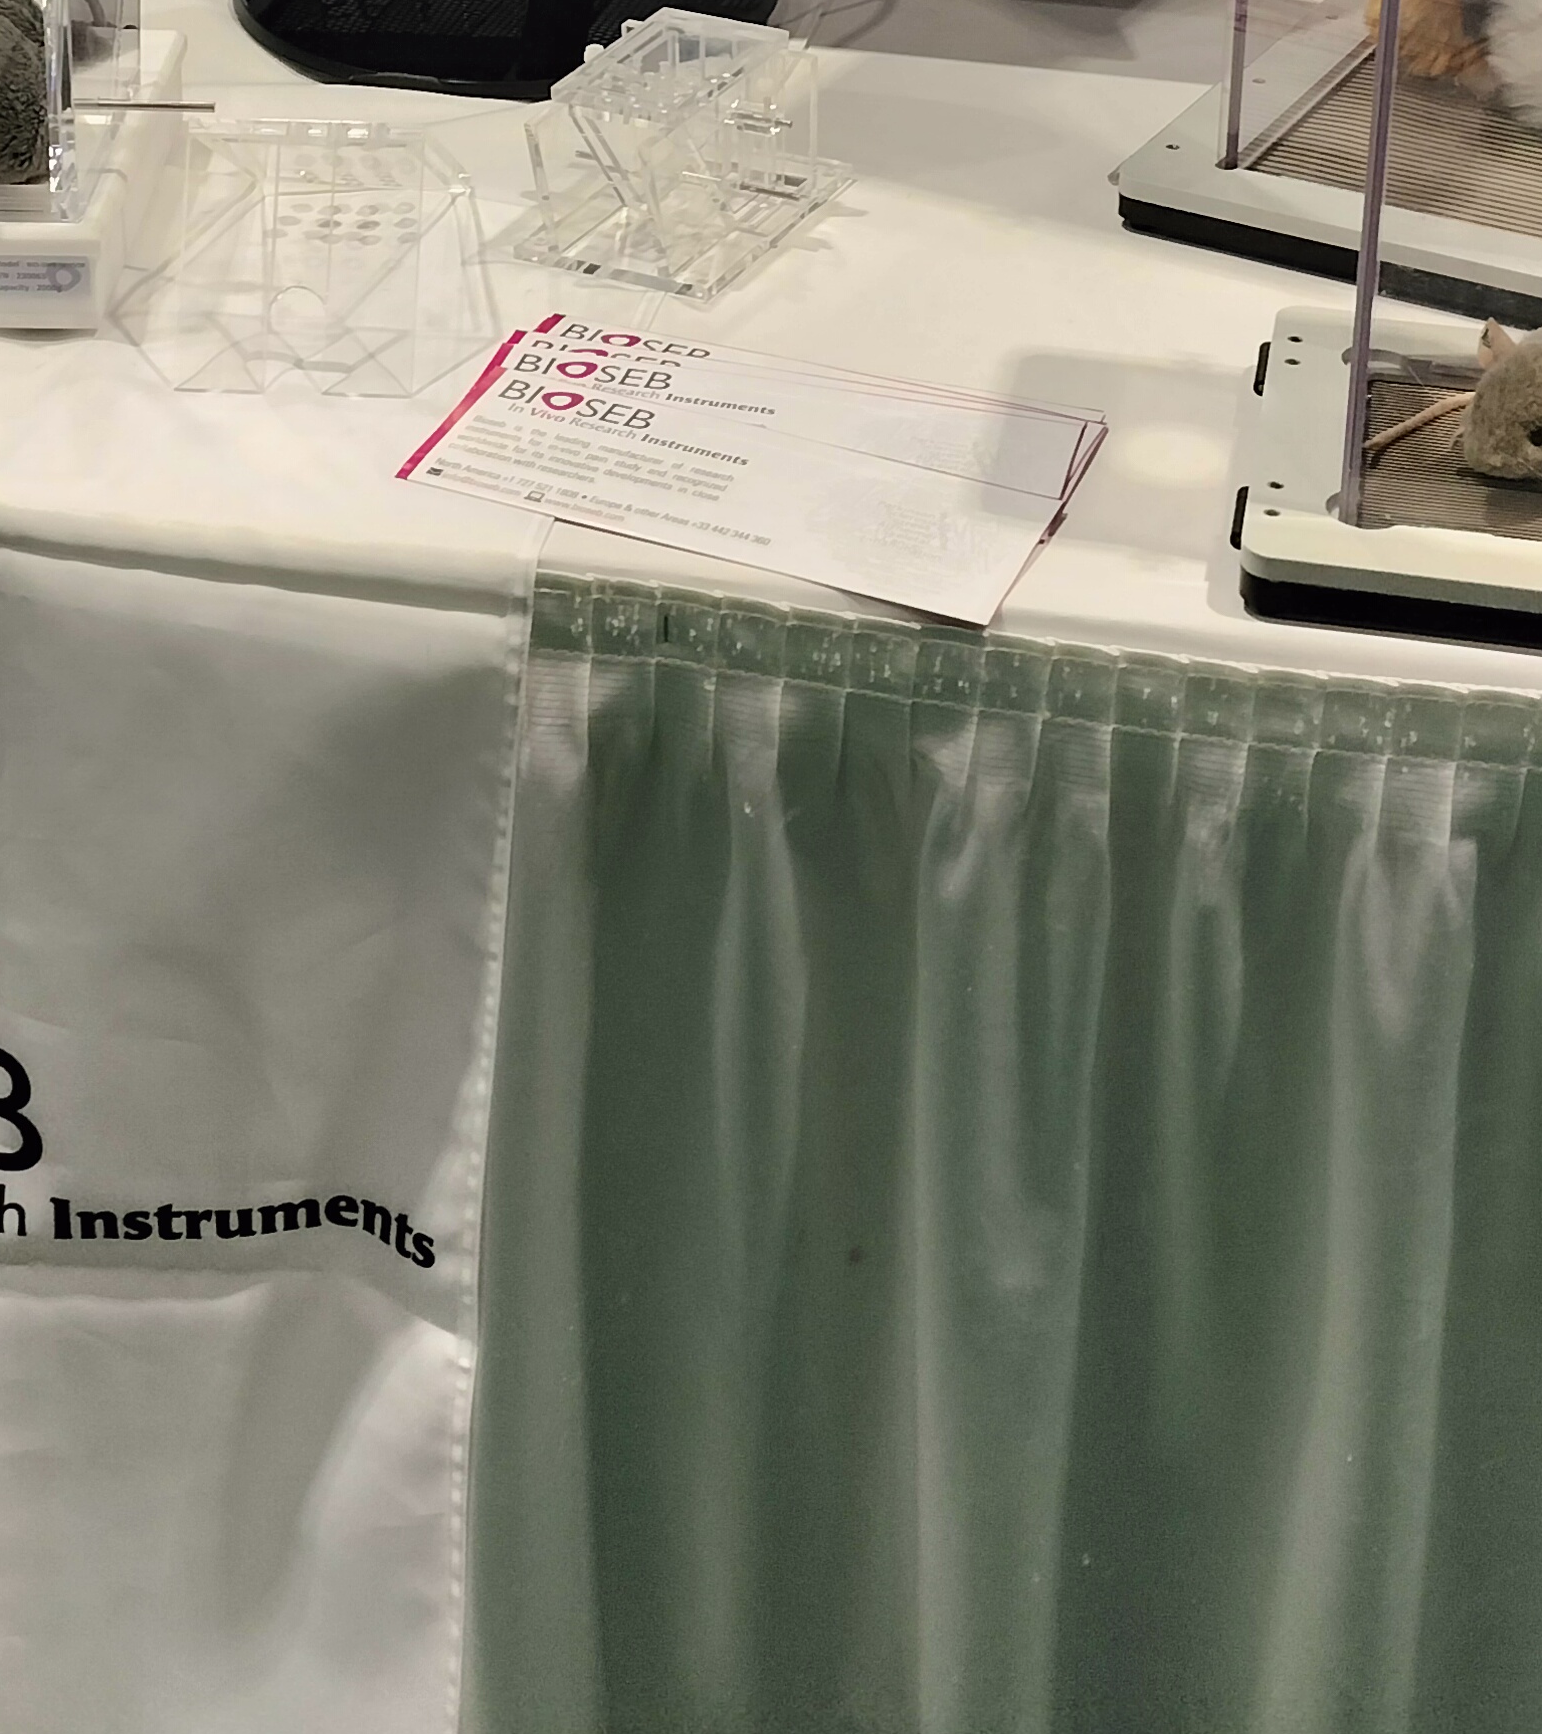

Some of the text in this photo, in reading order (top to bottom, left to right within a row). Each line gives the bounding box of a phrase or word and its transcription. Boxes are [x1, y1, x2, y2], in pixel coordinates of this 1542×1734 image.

[512, 352, 672, 390] BIOSEB
[497, 379, 655, 430] BIOSEB
[507, 402, 750, 467] In Vivo Research Instruments
[50, 1191, 435, 1271] Instruments
